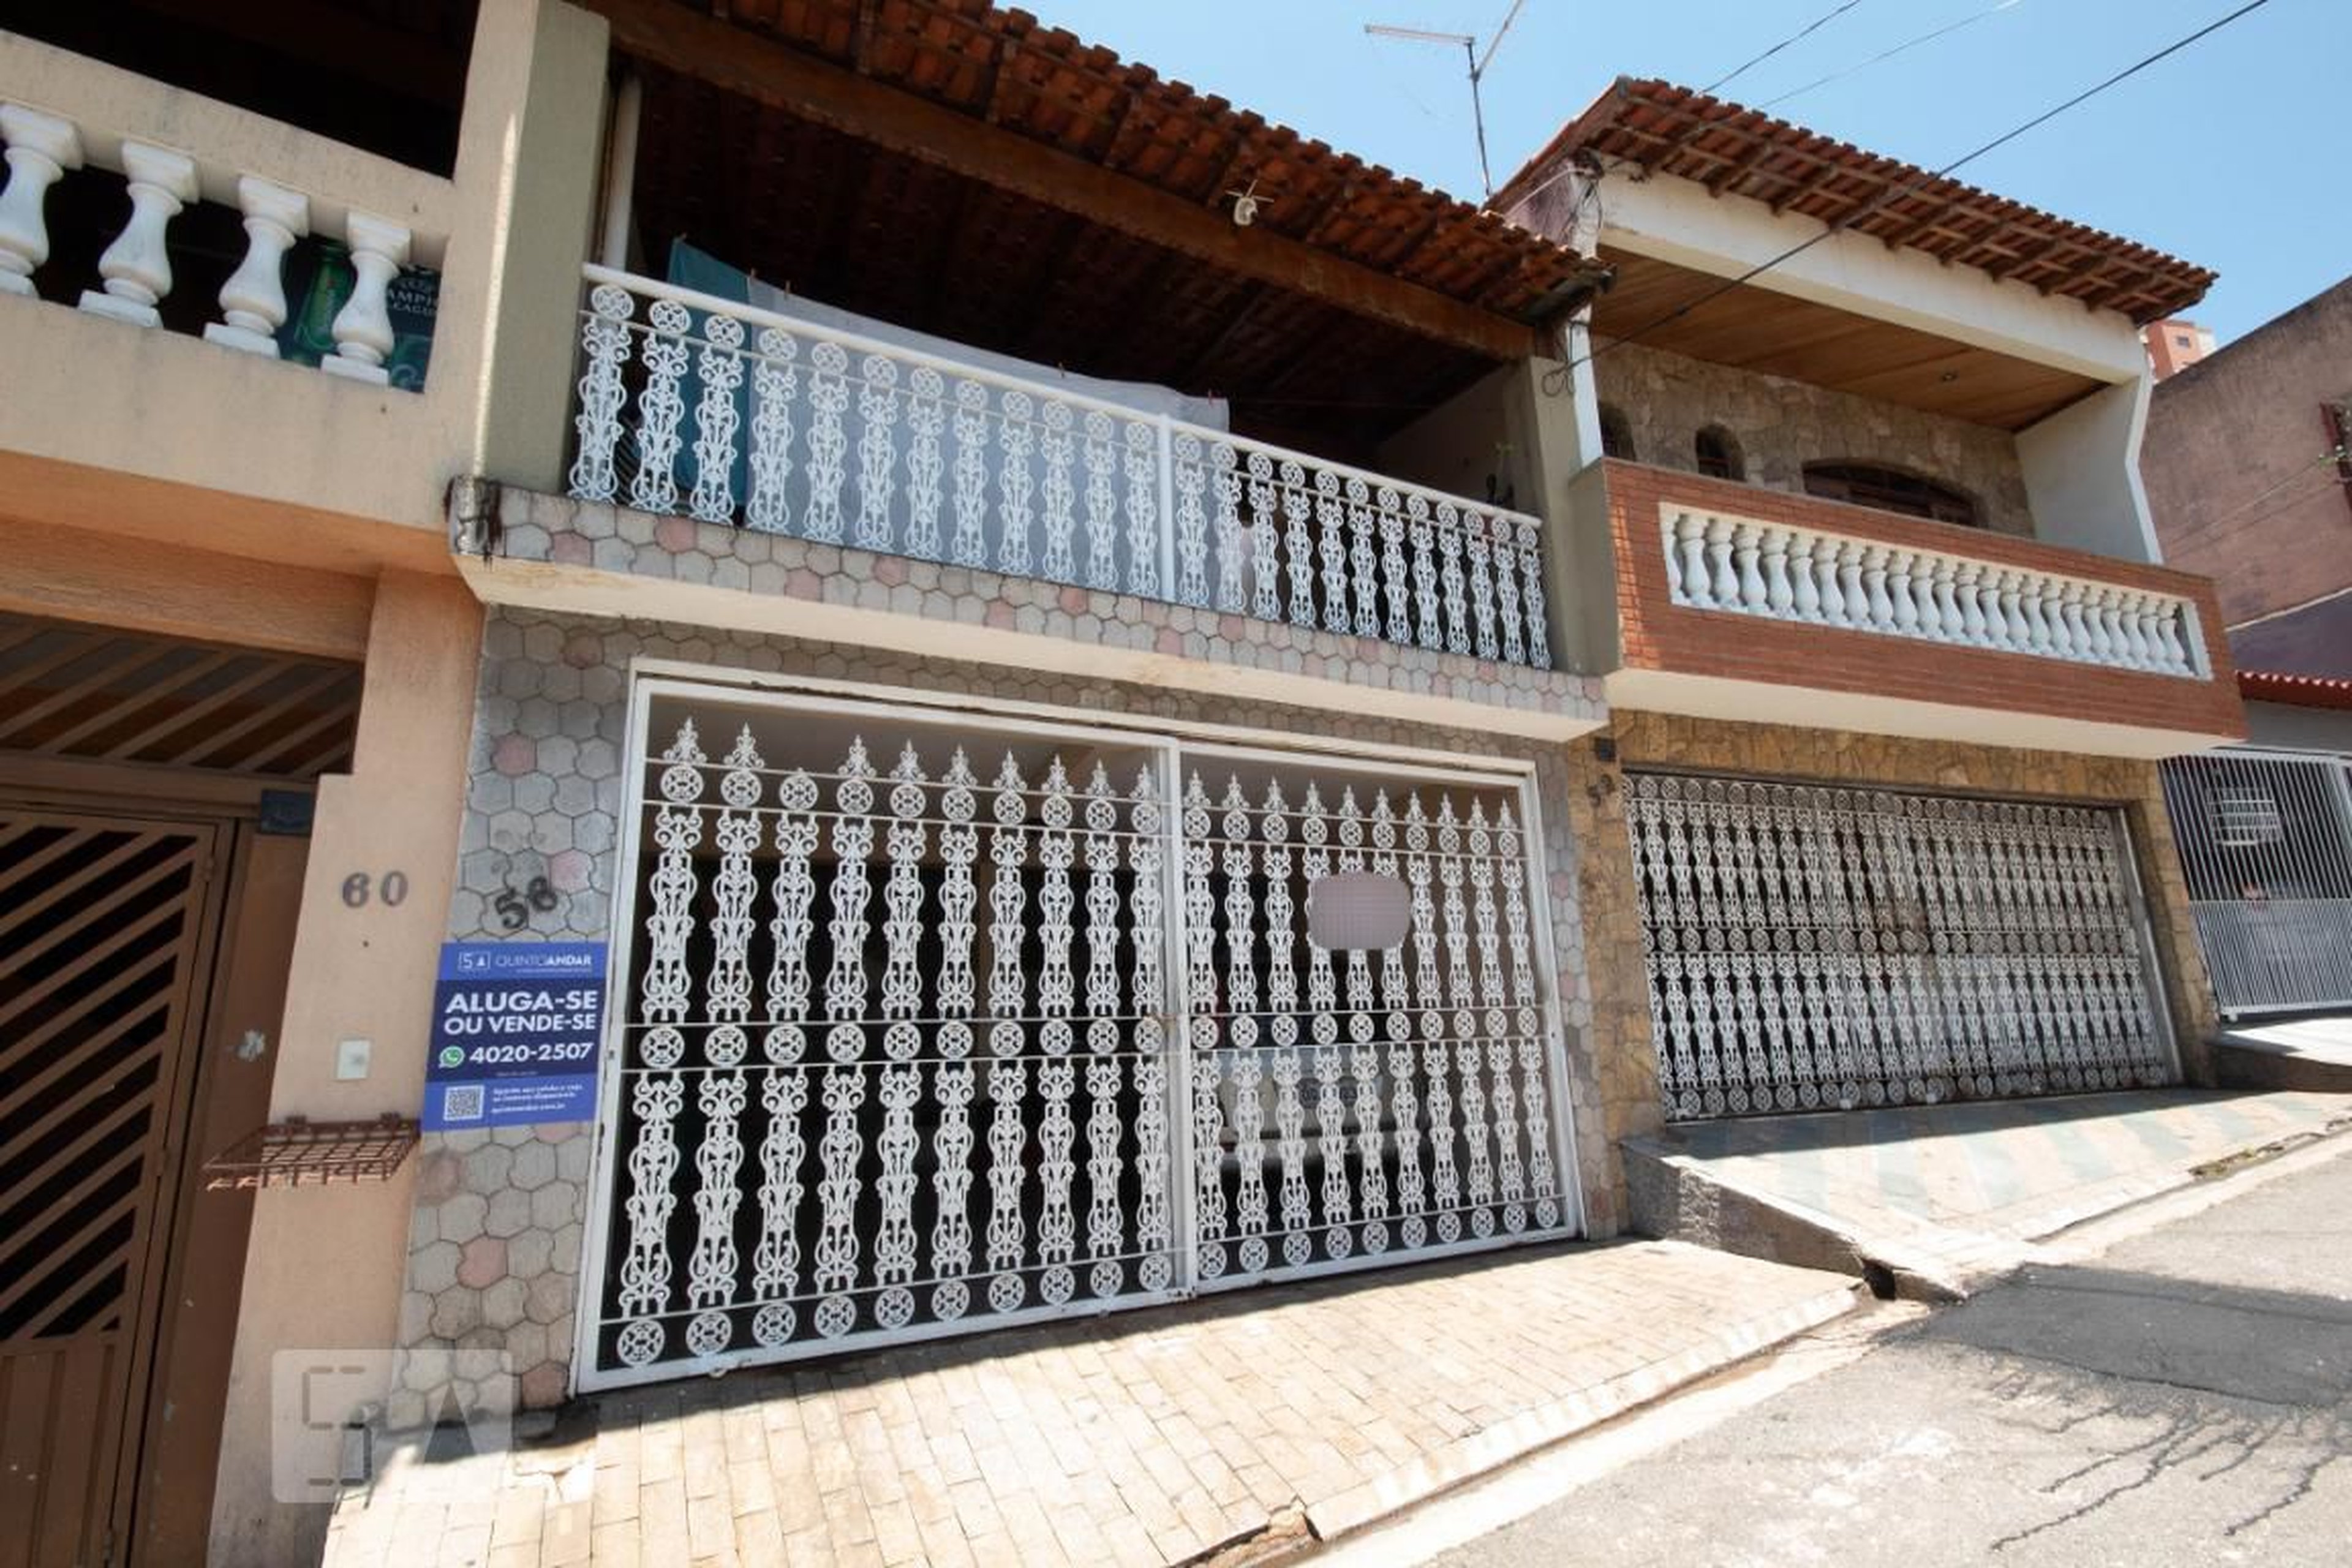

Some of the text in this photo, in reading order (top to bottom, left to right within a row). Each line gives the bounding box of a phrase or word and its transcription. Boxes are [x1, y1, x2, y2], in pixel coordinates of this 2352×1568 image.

[342, 870, 408, 908] 60
[494, 876, 558, 929] 58
[445, 990, 598, 1014] ALUGA-SE
[443, 1014, 597, 1035] OU VENDE-SE
[469, 1042, 594, 1063] 4020-2507
